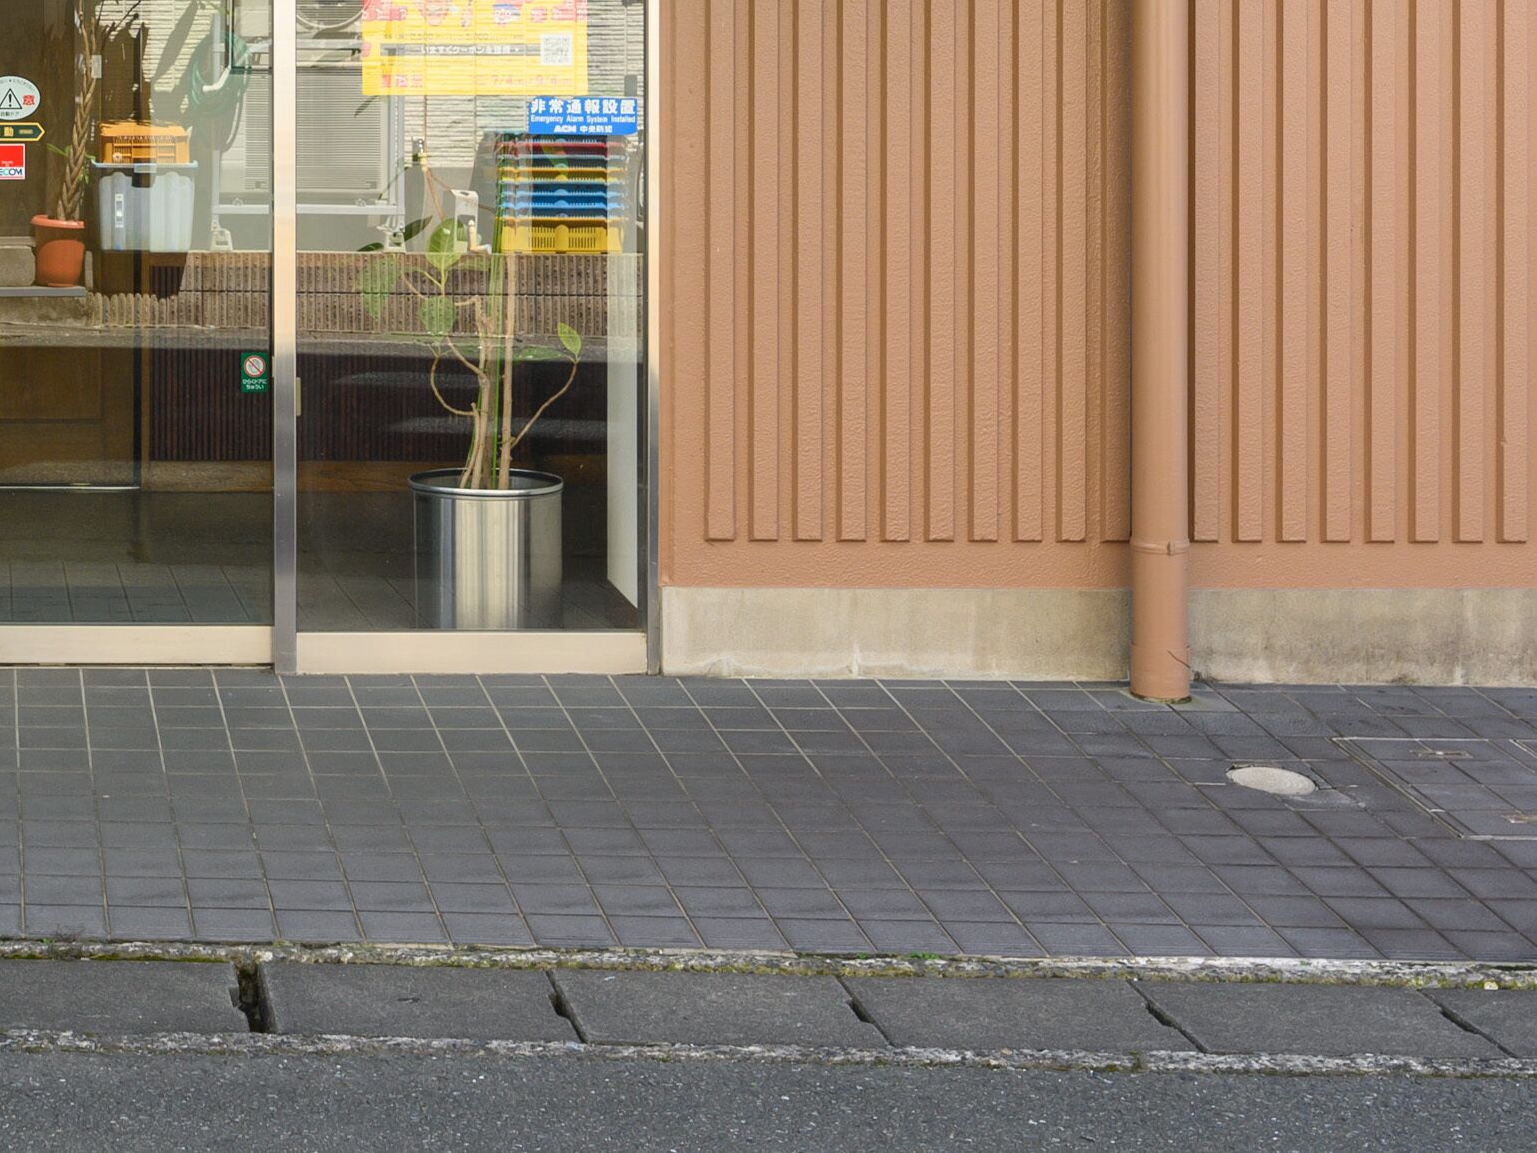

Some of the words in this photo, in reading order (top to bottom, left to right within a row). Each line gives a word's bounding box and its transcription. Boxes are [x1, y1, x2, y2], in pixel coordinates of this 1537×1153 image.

[530, 98, 636, 114] 非常通報設置
[530, 115, 564, 124] Emergency
[566, 115, 584, 123] Alarm
[586, 115, 608, 124] System
[610, 115, 636, 123] Installed
